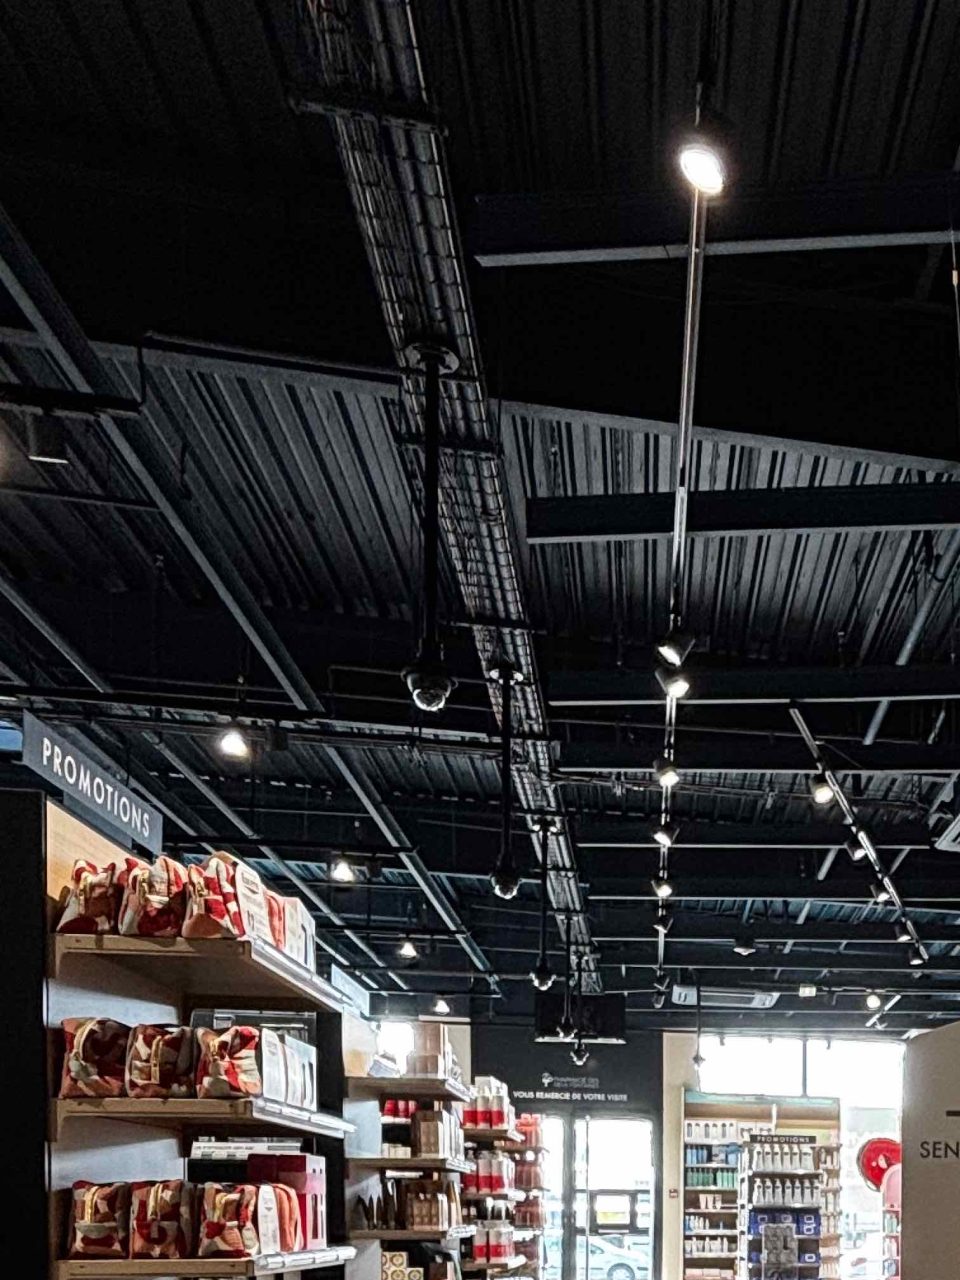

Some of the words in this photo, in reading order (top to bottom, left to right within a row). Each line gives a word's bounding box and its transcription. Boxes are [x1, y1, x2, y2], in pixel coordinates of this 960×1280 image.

[42, 737, 150, 838] PROMOTIONS
[513, 1091, 535, 1099] VOUS
[536, 1091, 571, 1100] REMERCIE
[572, 1092, 582, 1100] DE
[583, 1093, 606, 1101] VOTRE
[607, 1094, 629, 1102] VISITE
